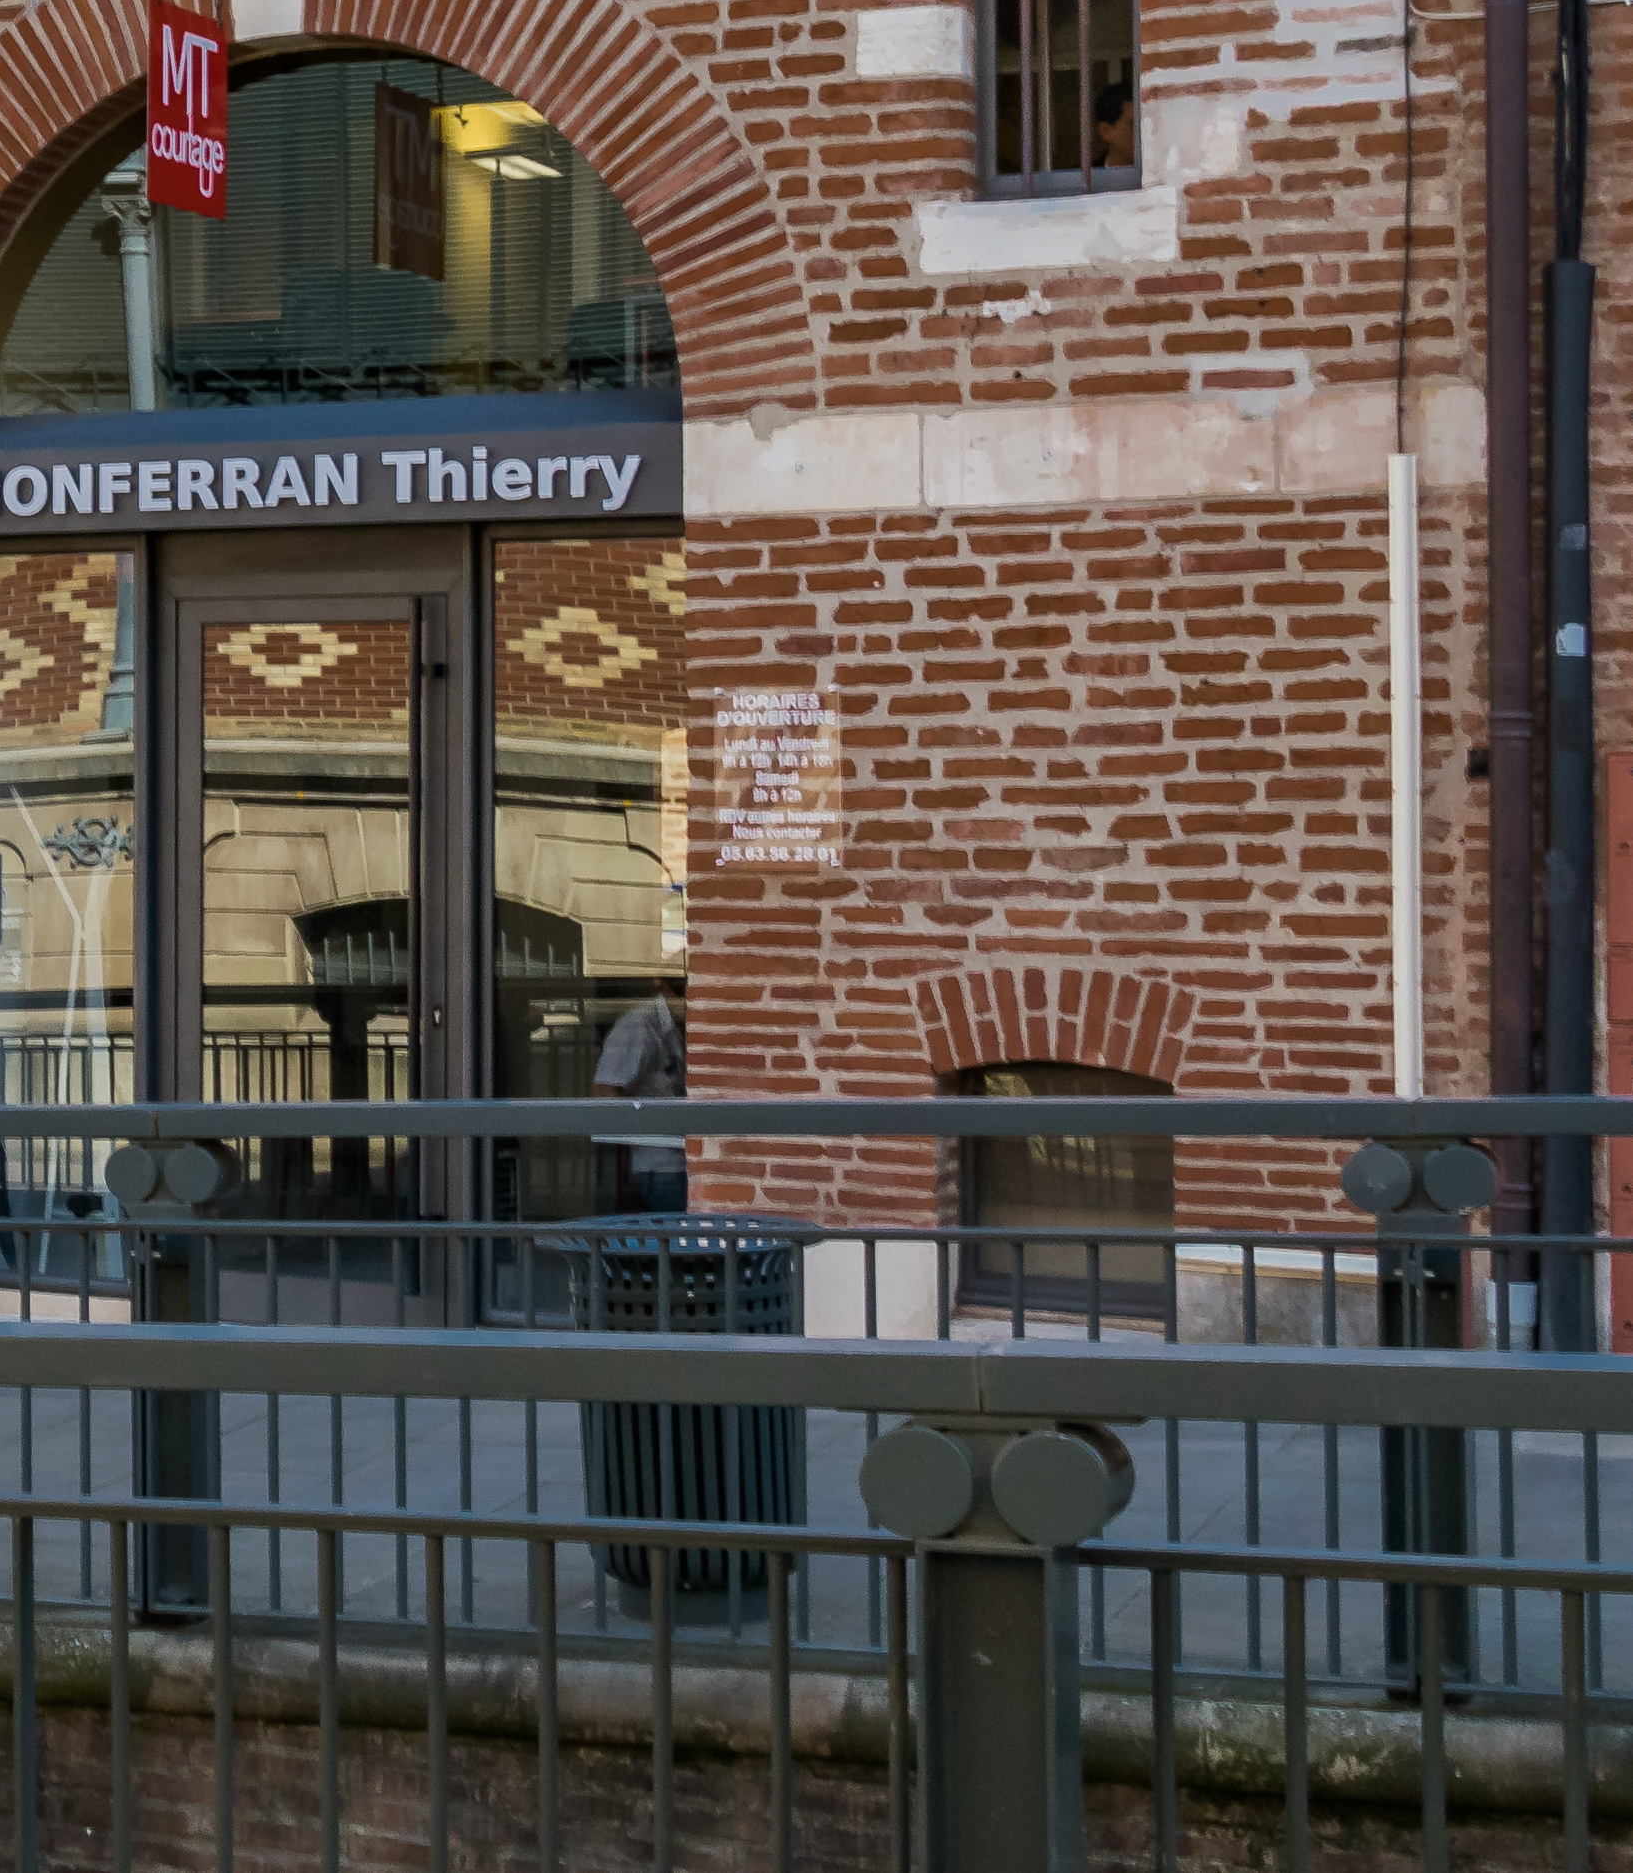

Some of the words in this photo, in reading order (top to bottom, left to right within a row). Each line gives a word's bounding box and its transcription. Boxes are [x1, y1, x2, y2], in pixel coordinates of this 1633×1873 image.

[161, 24, 220, 119] MT
[151, 120, 226, 200] courtage
[382, 446, 642, 511] Thierry
[732, 694, 820, 710] HORAIRES
[716, 710, 836, 726] D'OUVERTURE
[724, 736, 757, 751] Lundi
[760, 739, 775, 751] au
[777, 736, 830, 751] Vendredi
[756, 770, 799, 786] Samedi
[719, 809, 745, 823] RDV
[747, 811, 784, 823] autres
[788, 809, 835, 823] horaires
[733, 825, 763, 839] Nous
[766, 826, 822, 840] contacter
